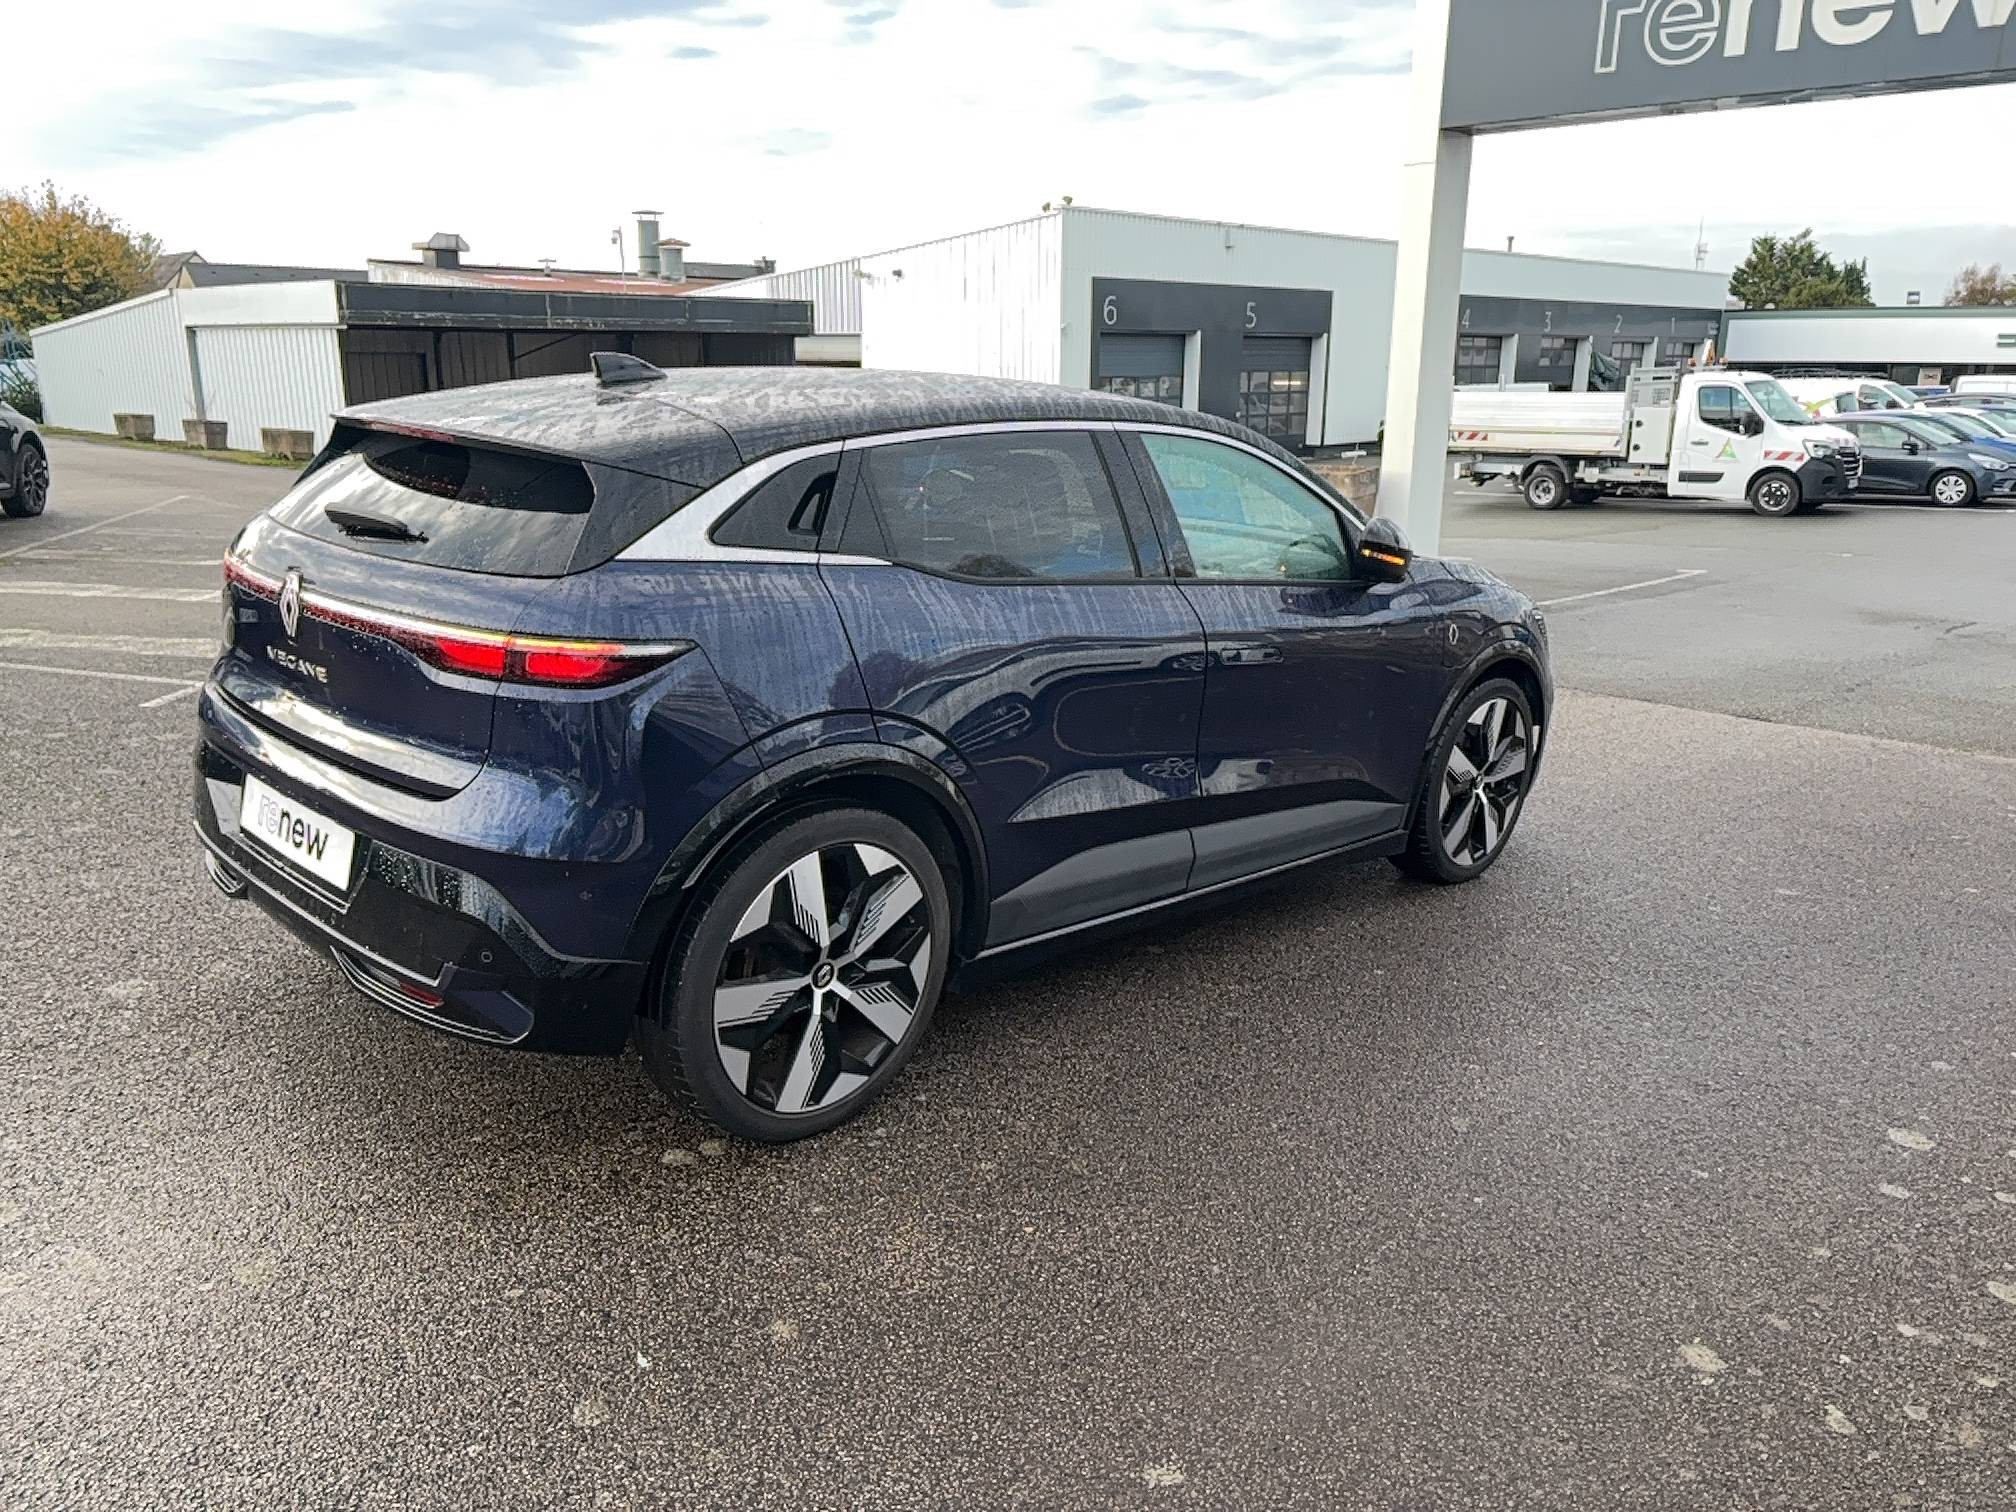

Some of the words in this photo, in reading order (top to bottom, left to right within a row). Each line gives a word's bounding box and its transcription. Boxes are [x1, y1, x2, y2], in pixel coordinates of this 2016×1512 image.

[1103, 295, 1117, 325] 6
[1245, 302, 1257, 329] 5
[1461, 308, 1471, 329] 4
[1544, 311, 1552, 333] 3
[1614, 314, 1624, 334] 2
[258, 794, 329, 860] renew
